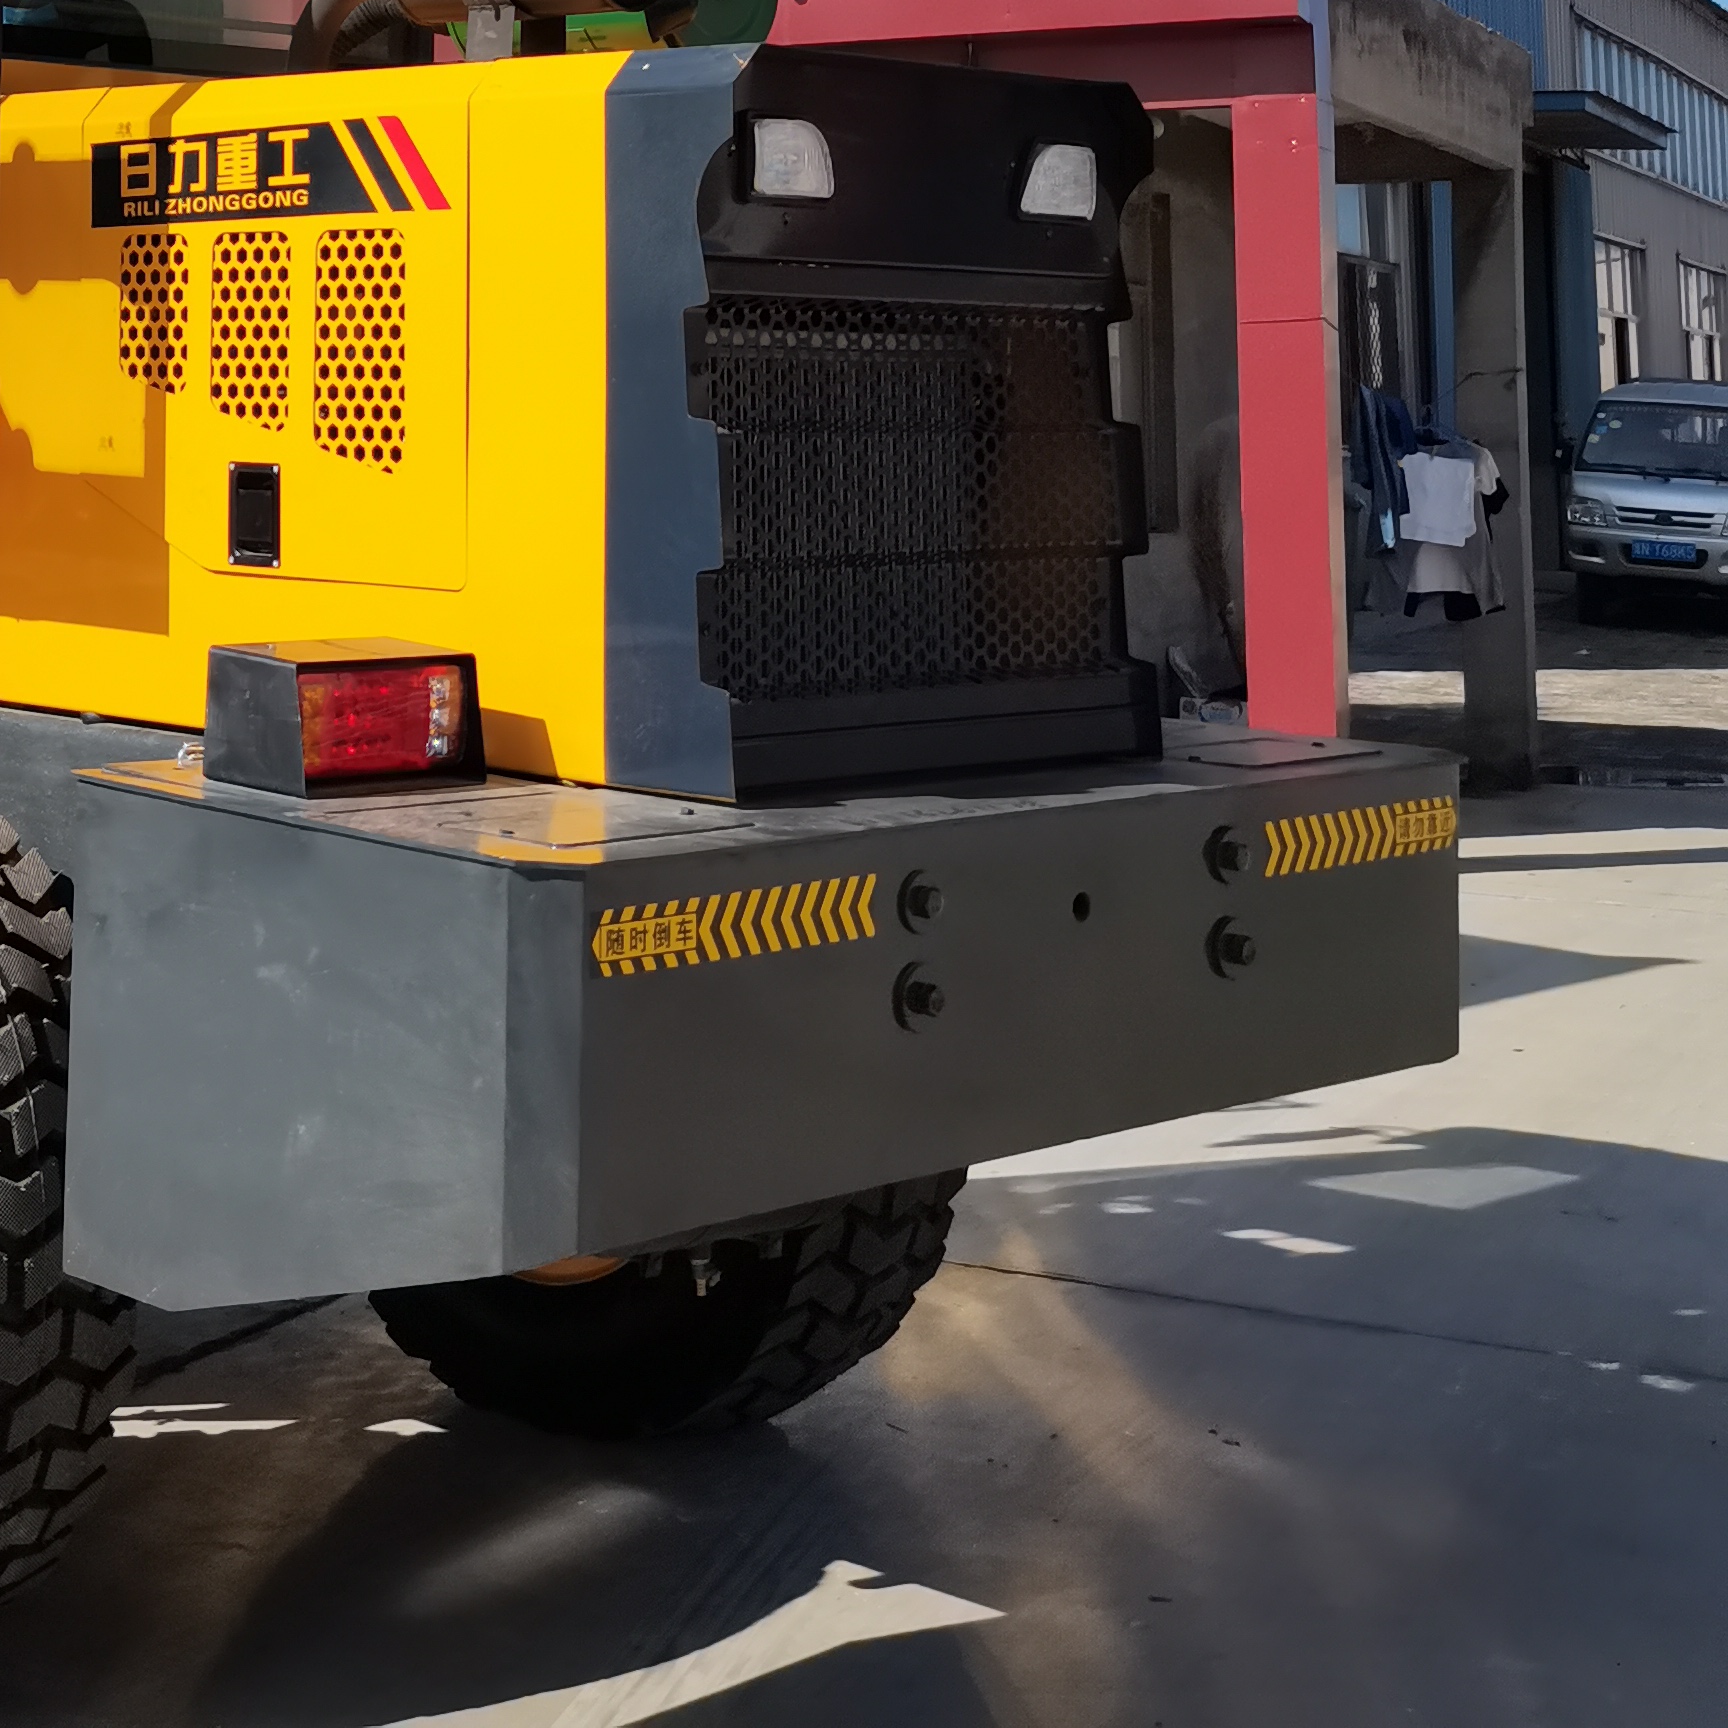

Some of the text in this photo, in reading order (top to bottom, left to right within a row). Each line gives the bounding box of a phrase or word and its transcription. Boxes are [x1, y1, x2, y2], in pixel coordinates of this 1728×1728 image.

[119, 128, 311, 199] 日力重工
[123, 188, 310, 218] RILI ZHONGGONG
[605, 917, 694, 958] 随时倒车
